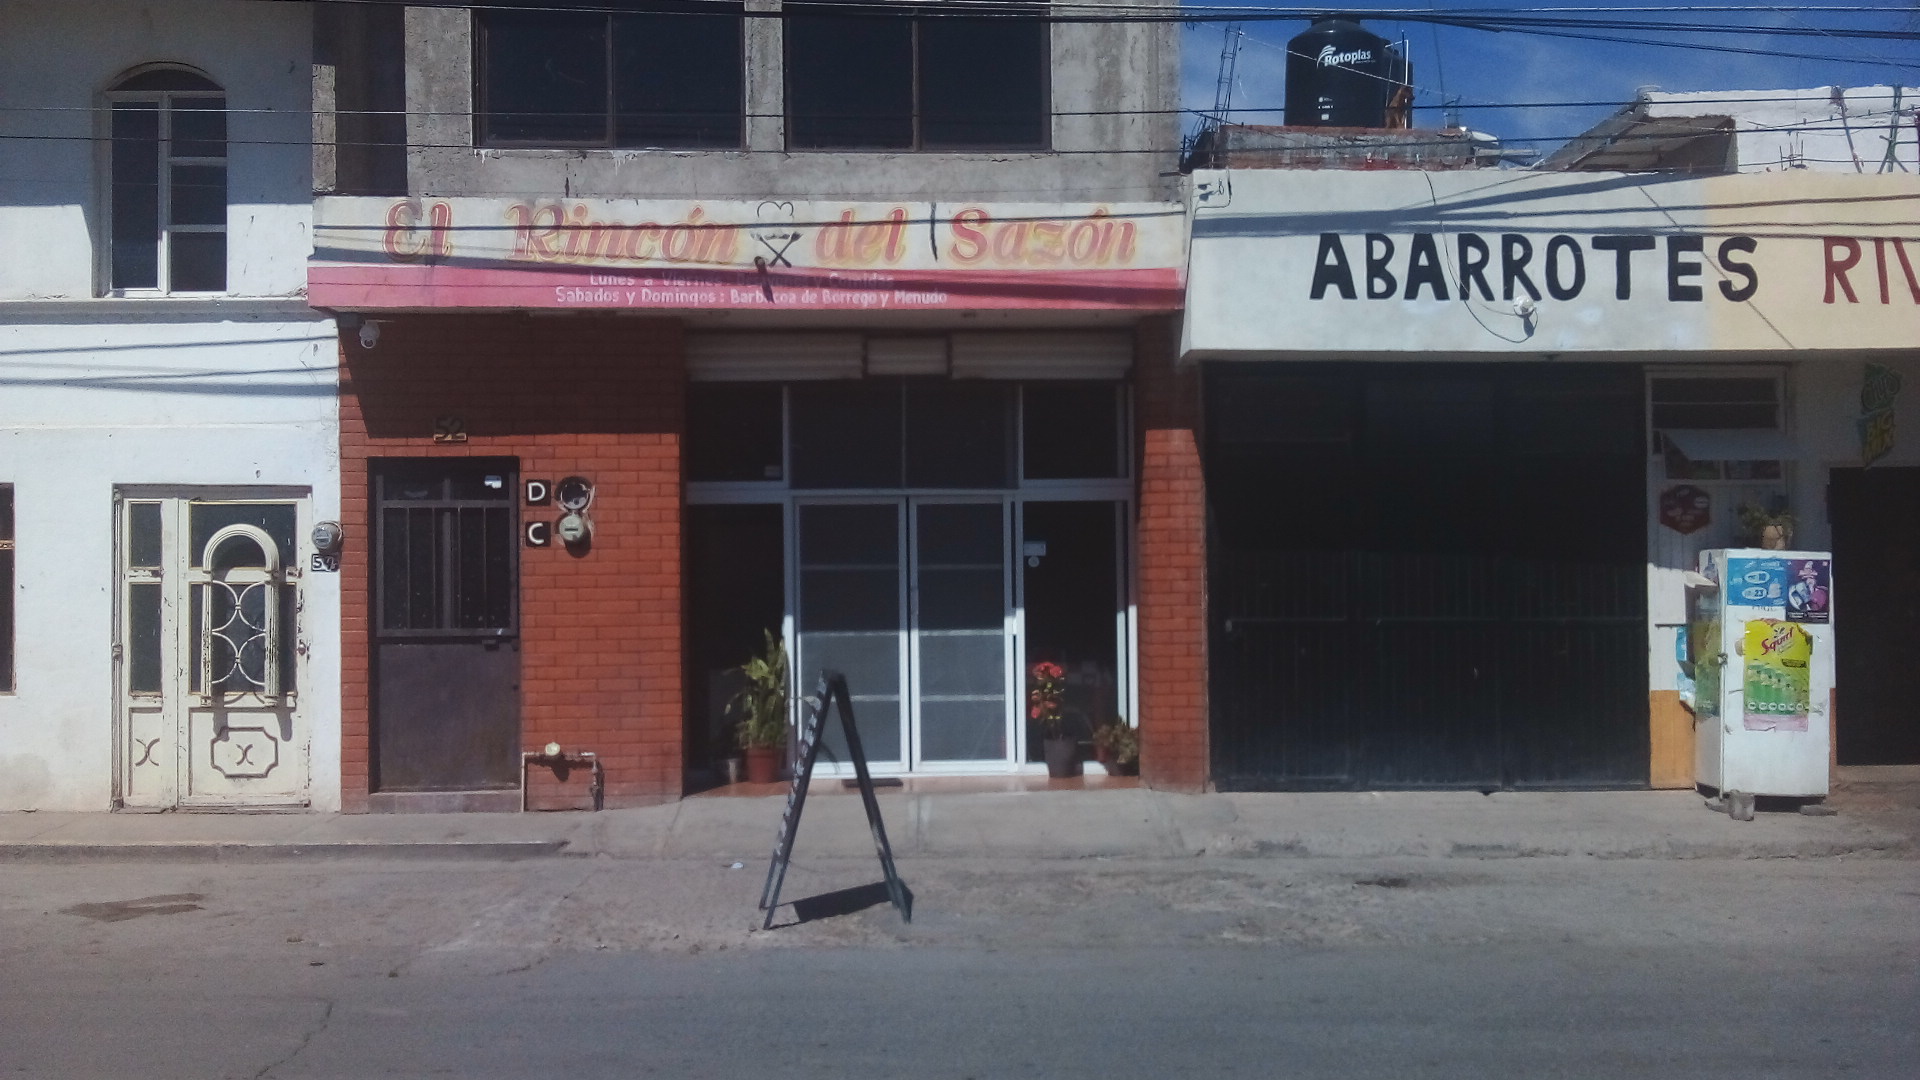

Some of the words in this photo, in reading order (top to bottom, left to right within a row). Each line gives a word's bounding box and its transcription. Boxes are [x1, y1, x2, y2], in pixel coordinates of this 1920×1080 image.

[1324, 49, 1371, 66] Rotoplas
[383, 200, 453, 262] El
[504, 203, 740, 264] Rincón
[815, 207, 908, 264] del
[948, 204, 1137, 265] Sazón
[1308, 232, 1760, 303] ABARROTES
[590, 271, 635, 286] Lunes
[556, 287, 619, 302] Sabados
[626, 291, 635, 305] y
[802, 289, 817, 304] de
[822, 290, 877, 307] Borrego
[880, 293, 889, 307] y
[895, 290, 947, 305] Menudo
[528, 482, 546, 502] D
[528, 522, 545, 545] C
